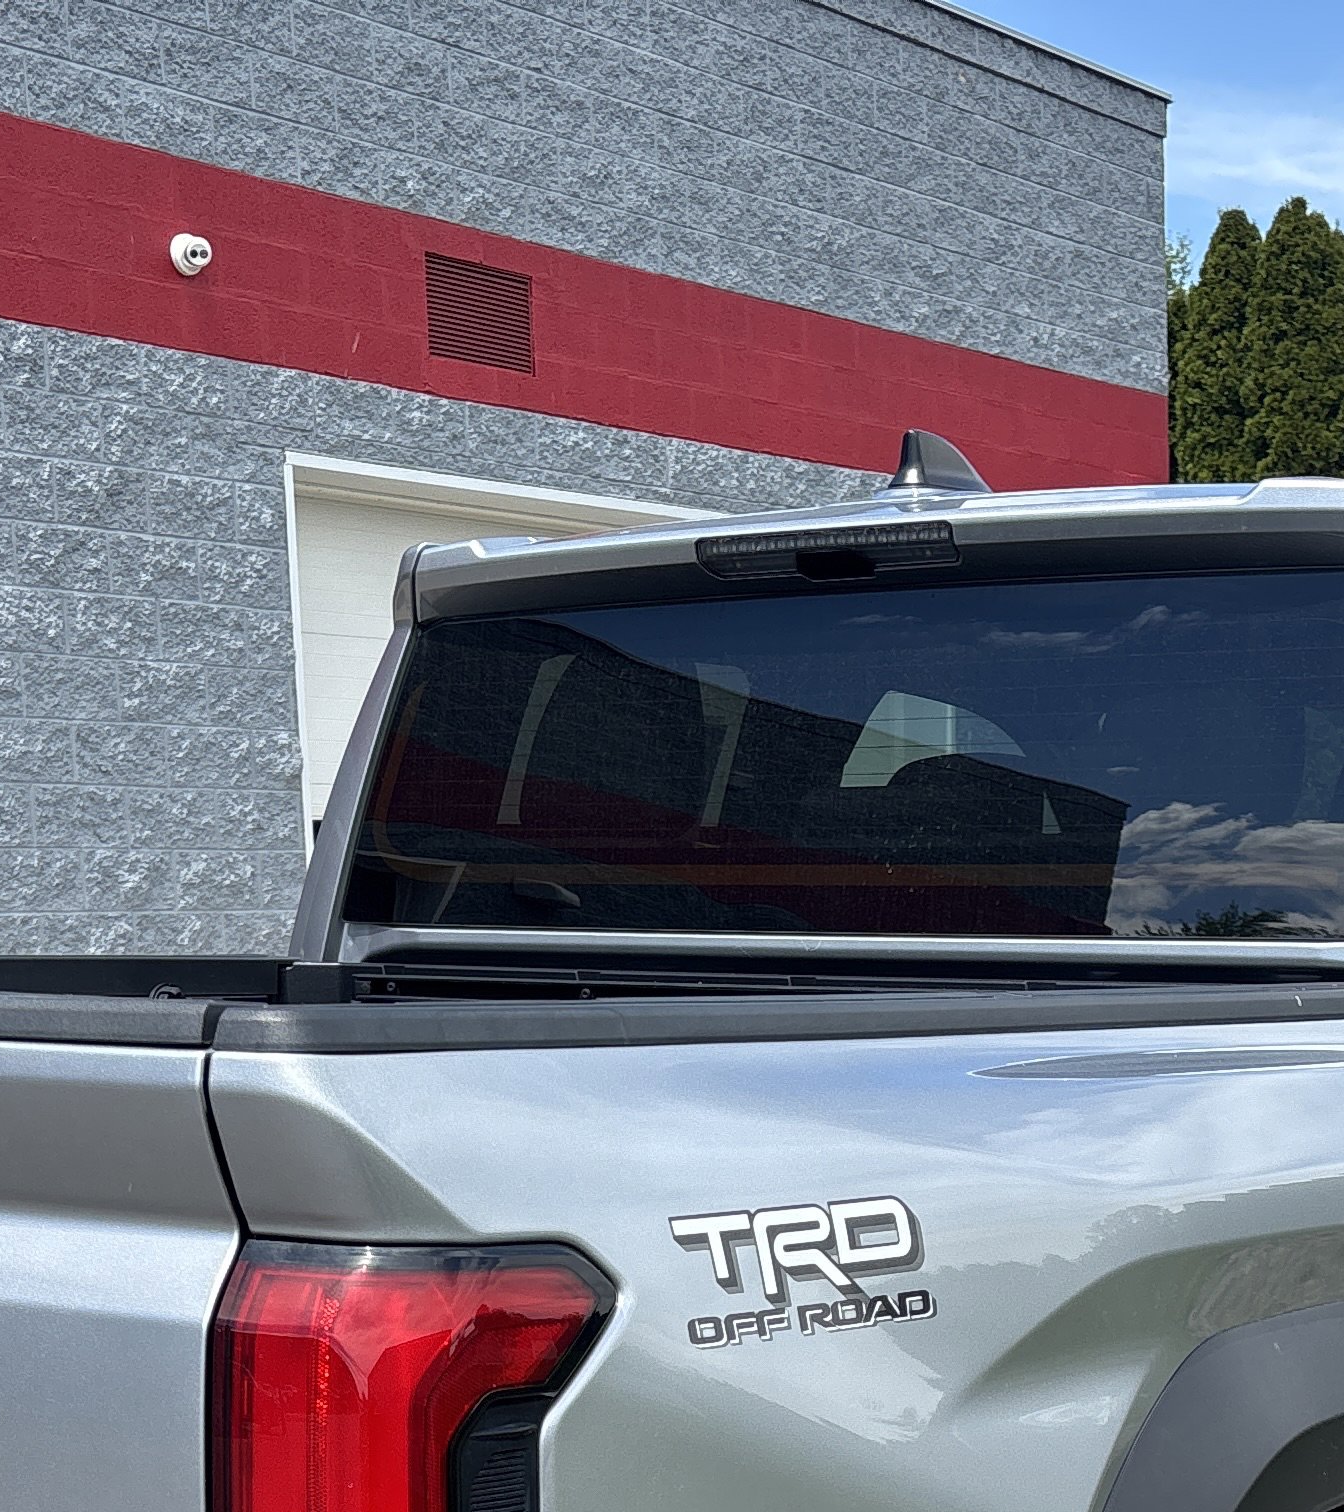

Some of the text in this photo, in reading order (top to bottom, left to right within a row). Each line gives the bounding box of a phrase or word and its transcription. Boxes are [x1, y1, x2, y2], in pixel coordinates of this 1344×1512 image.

[668, 1195, 925, 1309] TRD
[687, 1289, 938, 1350] OFF ROAD
